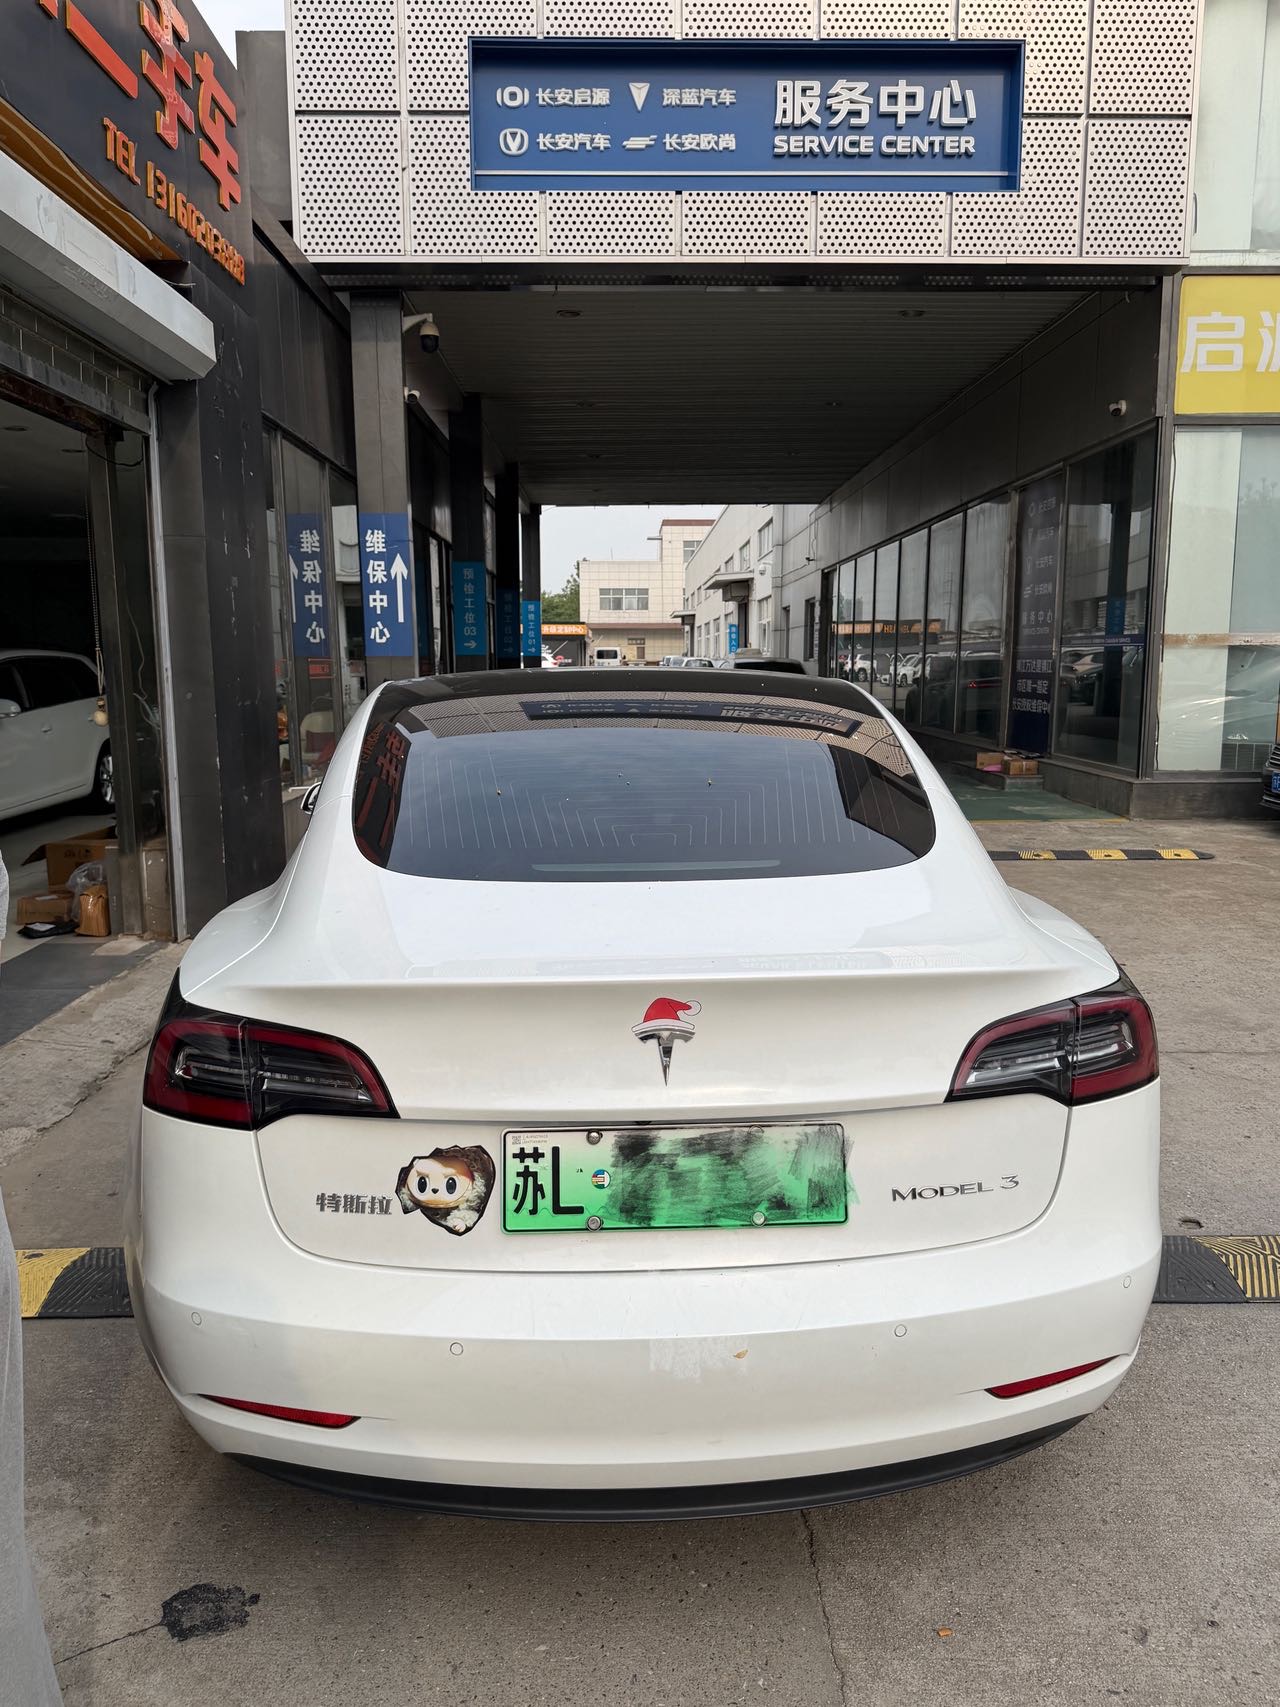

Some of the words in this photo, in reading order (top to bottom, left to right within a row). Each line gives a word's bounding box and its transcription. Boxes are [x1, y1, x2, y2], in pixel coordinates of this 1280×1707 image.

[536, 88, 611, 106] 长安启源
[662, 88, 737, 106] 深蓝汽车
[774, 80, 977, 126] 服务中心
[103, 117, 141, 186] TEL
[537, 133, 611, 151] 长安汽车
[662, 133, 737, 151] 长安欧尚
[774, 135, 874, 156] SERVICE
[880, 135, 976, 156] CENTER
[365, 529, 391, 643] 维保中心
[891, 1181, 994, 1202] MODEL
[1001, 1174, 1020, 1190] 3
[316, 1192, 394, 1216] 特斯拉
